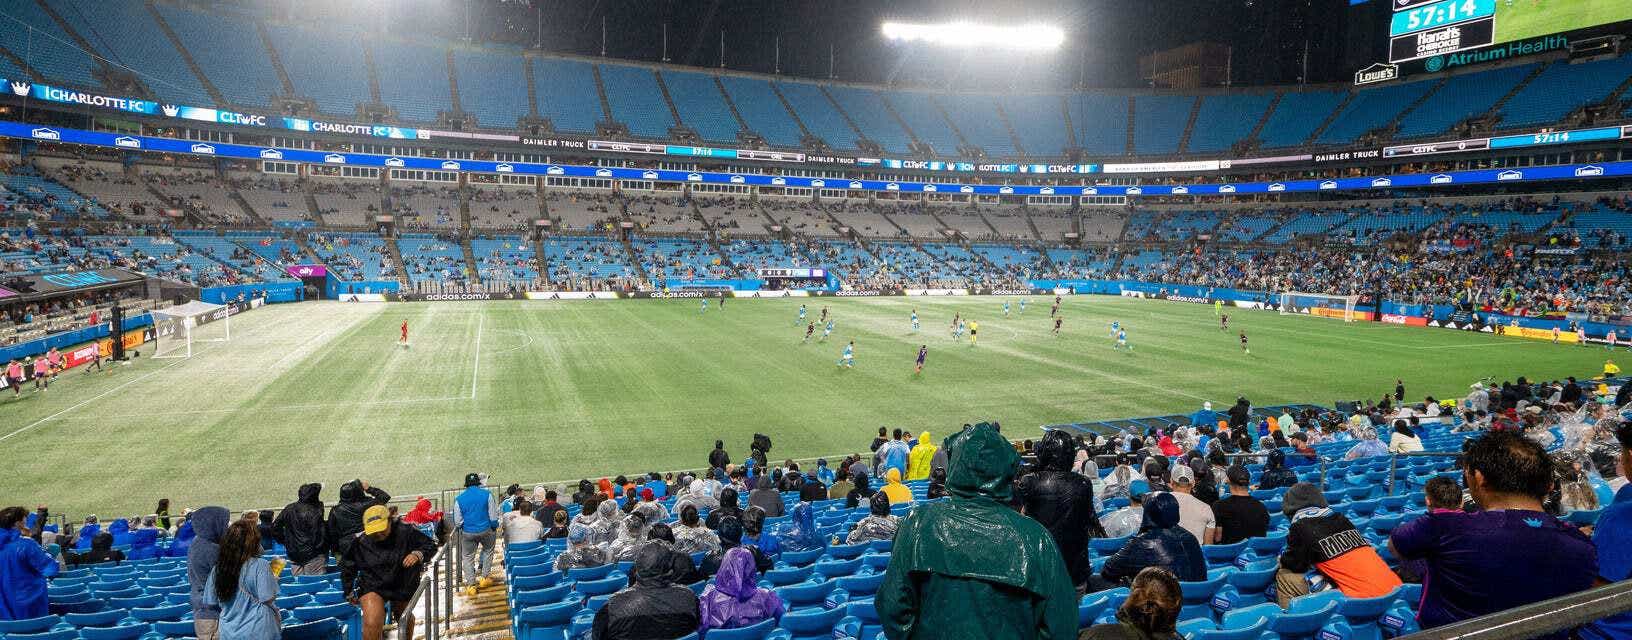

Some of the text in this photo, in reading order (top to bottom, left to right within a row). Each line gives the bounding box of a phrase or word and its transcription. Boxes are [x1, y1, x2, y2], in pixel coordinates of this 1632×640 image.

[1408, 0, 1476, 29] 57:14
[1447, 36, 1568, 67] Atrium Health
[1359, 68, 1394, 82] LOWE'S
[50, 88, 144, 112] CHARLOTTE FC
[312, 122, 372, 135] CHARLOTTE
[523, 138, 584, 148] DAIMLER TRUCK
[1316, 151, 1379, 162] DAIMLER TRUCK
[300, 267, 313, 275] ally
